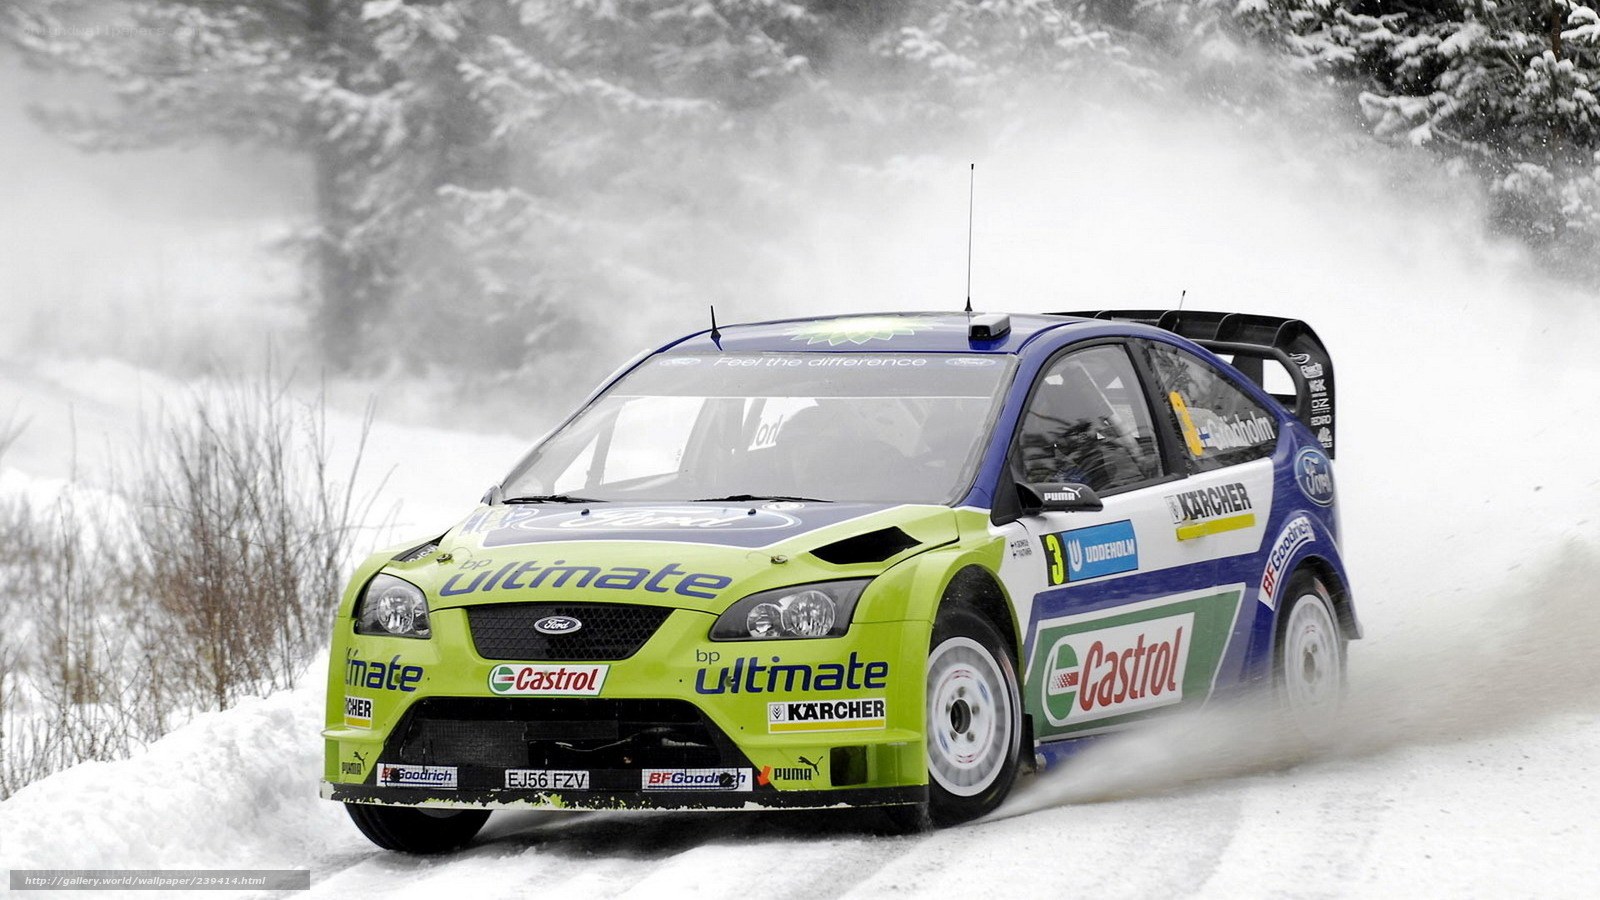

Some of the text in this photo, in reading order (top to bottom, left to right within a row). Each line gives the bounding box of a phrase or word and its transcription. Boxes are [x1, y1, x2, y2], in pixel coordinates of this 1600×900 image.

[713, 356, 762, 367] Feel
[765, 356, 802, 367] the
[808, 356, 928, 367] difference
[1303, 456, 1333, 495] Ford
[1044, 492, 1075, 501] PUMA
[1176, 482, 1252, 521] KÄRCHER
[559, 510, 750, 529] Ford
[1046, 534, 1064, 585] 3
[1085, 538, 1136, 563] UDDEHOLM
[1263, 518, 1312, 599] BFGoodrich
[458, 558, 492, 571] bp
[439, 559, 733, 600] ultimate
[543, 618, 571, 630] Ford
[696, 649, 721, 665] bp
[515, 667, 599, 691] Castrol
[695, 651, 889, 695] ultimate
[1079, 625, 1184, 712] Castrol
[787, 700, 885, 721] KÄRCHER
[508, 772, 586, 788] EJ56 FZV
[773, 767, 812, 781] PUMA
